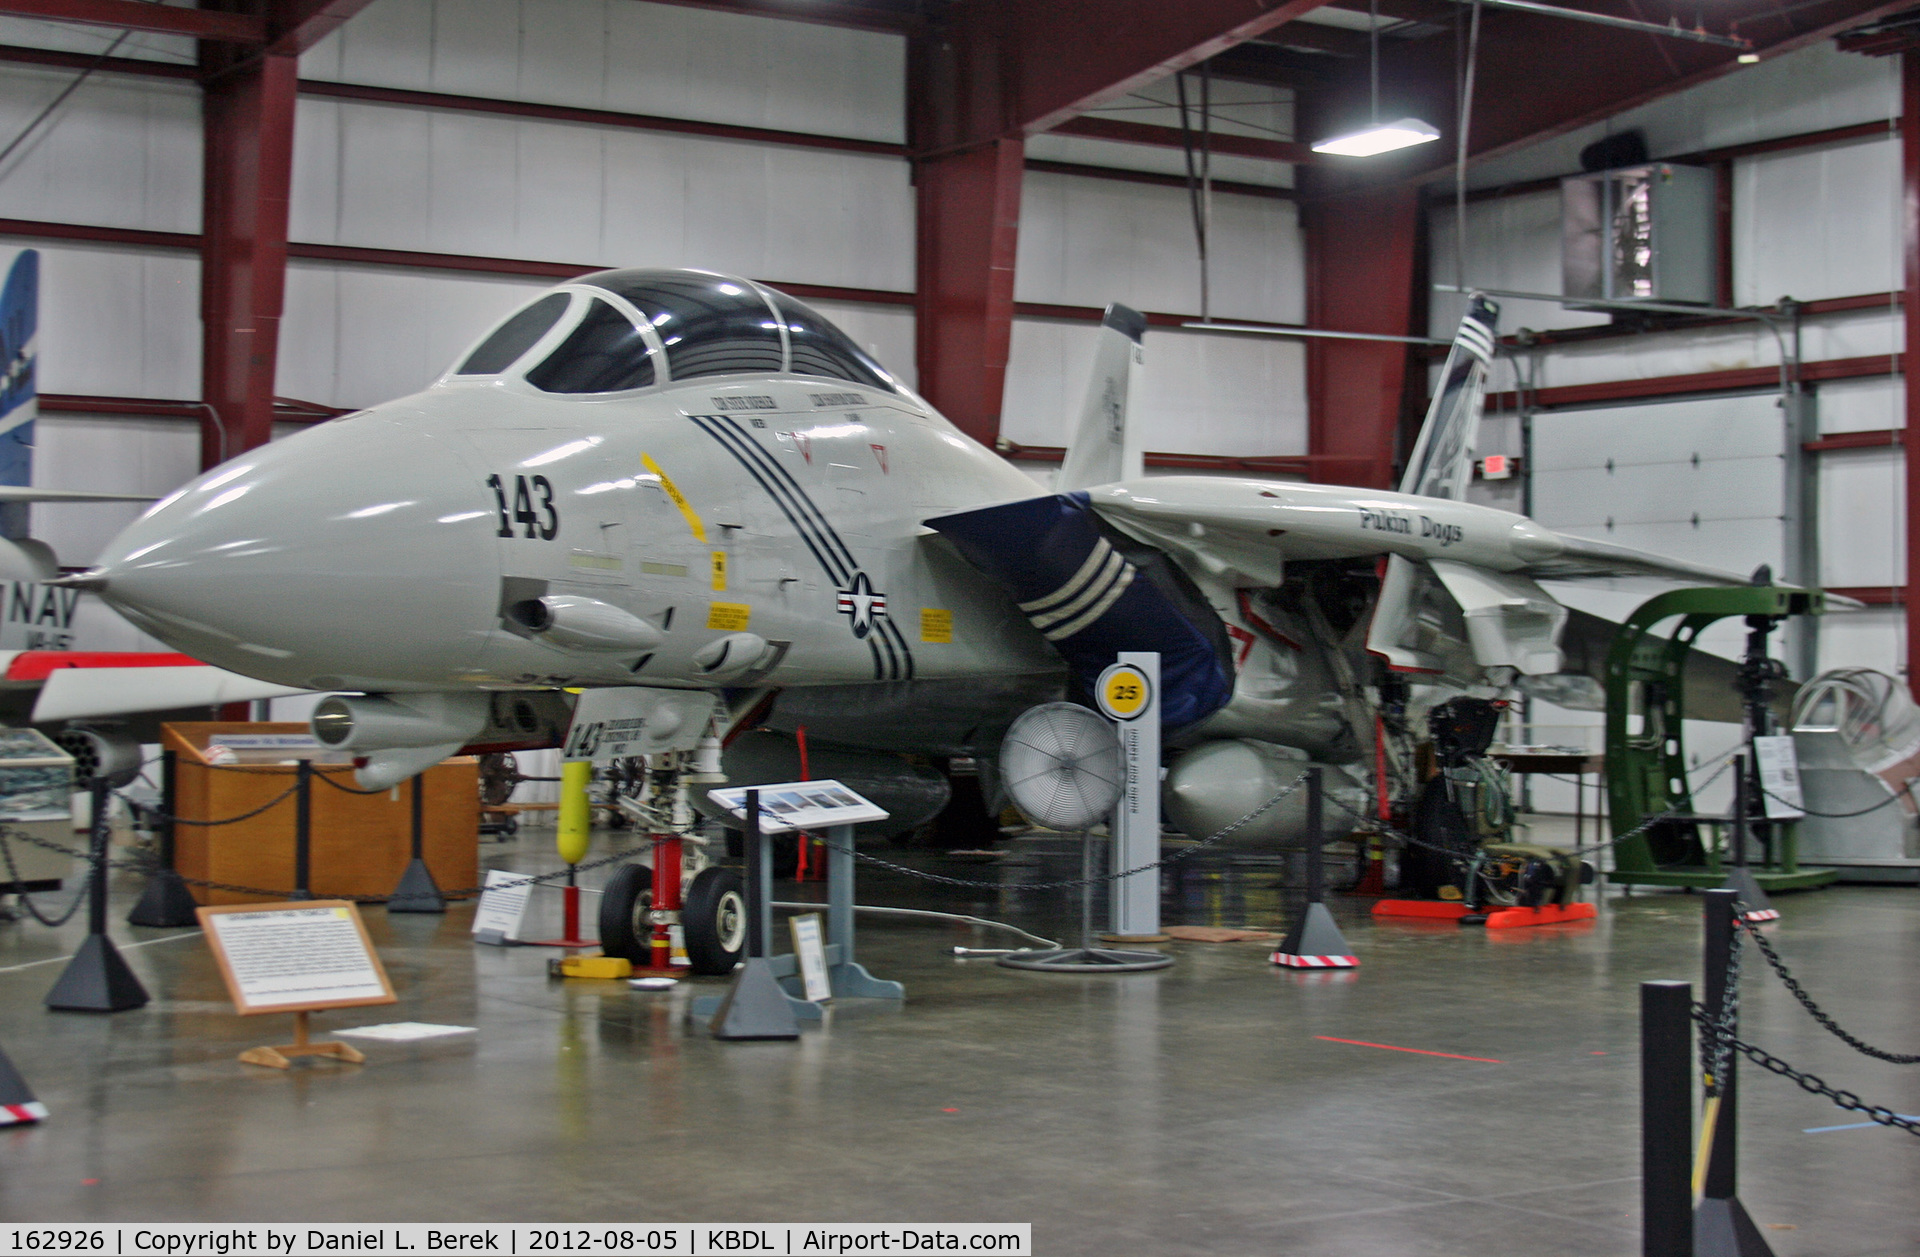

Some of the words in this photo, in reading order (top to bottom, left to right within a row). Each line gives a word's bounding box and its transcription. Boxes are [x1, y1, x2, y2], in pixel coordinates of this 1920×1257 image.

[485, 473, 558, 541] 143
[1419, 515, 1464, 547] Dogs
[1114, 685, 1139, 700] 25
[564, 722, 605, 758] 143
[1128, 729, 1139, 762] station
[1128, 764, 1139, 784] tour
[1128, 787, 1139, 814] audio
